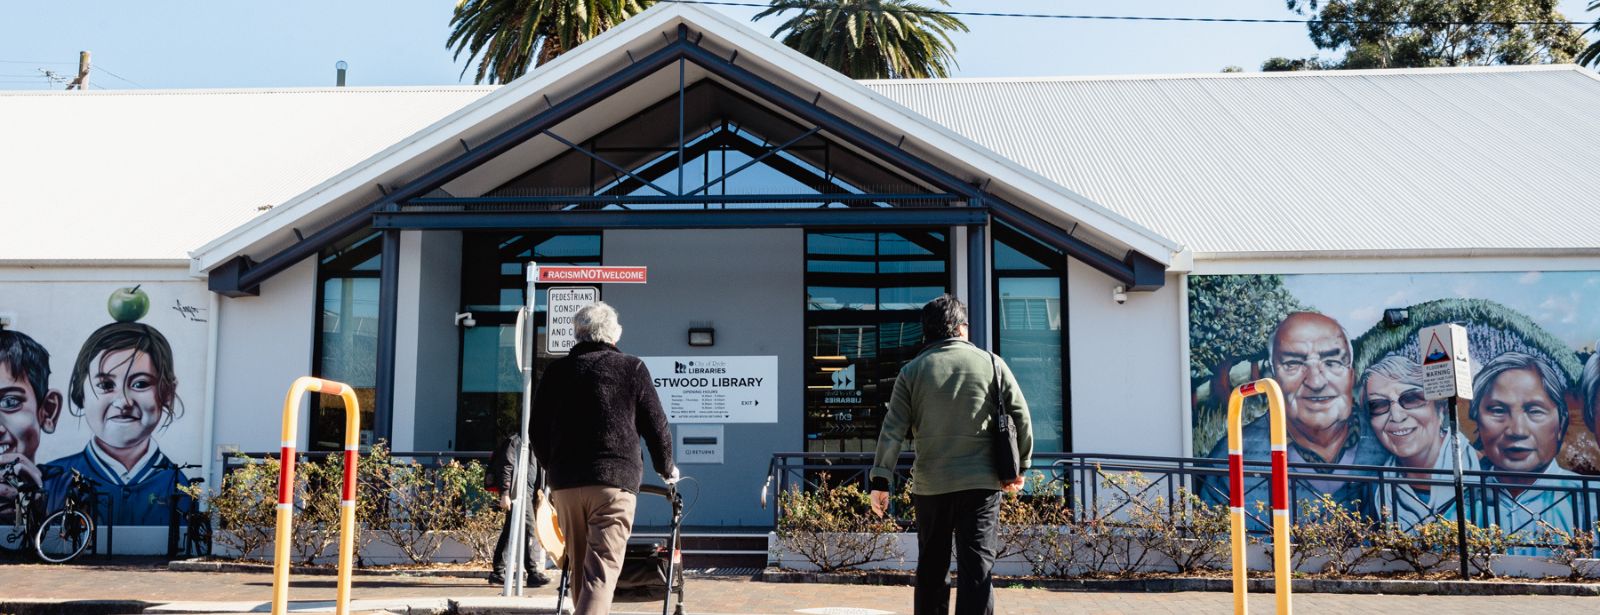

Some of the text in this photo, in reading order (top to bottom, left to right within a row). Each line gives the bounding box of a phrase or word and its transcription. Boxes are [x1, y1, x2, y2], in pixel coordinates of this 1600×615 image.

[543, 269, 644, 279] #RACISMNOTWELCOME
[551, 293, 593, 301] PEDESTRIANS
[554, 304, 582, 313] CONSID
[552, 316, 574, 325] MOTO
[551, 328, 566, 336] AND
[552, 340, 576, 348] IN GRO
[1426, 368, 1451, 377] WARNING
[654, 377, 764, 388] STWOOD LIBRARY
